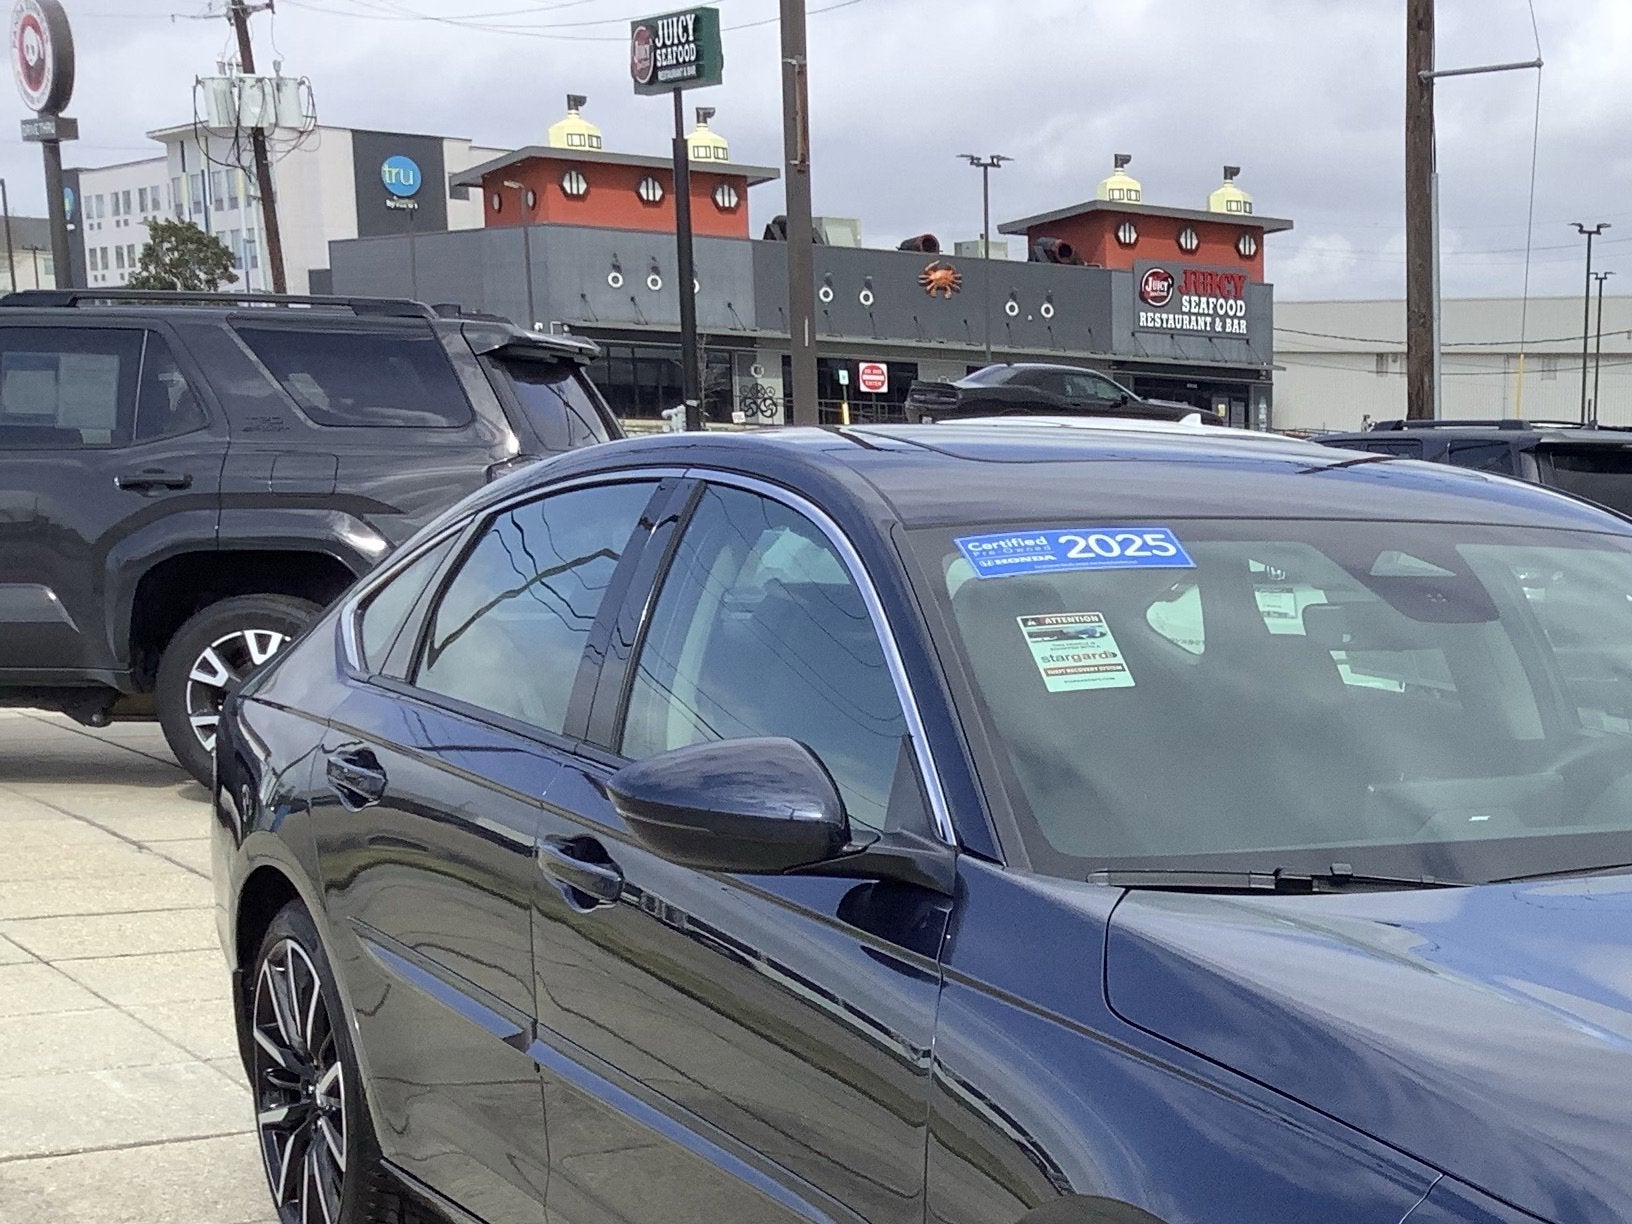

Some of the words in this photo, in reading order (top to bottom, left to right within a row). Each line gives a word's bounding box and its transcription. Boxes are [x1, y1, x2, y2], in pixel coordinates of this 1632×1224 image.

[655, 14, 696, 47] JUICY
[655, 43, 697, 67] SEAFOOD
[383, 163, 413, 186] tru
[1177, 269, 1247, 299] JUICY
[1181, 295, 1246, 317] SEAFOOD
[1139, 311, 1212, 331] RESTAURANT
[1214, 317, 1223, 333] &
[1225, 318, 1247, 334] BAR
[967, 536, 1048, 551] Certified
[1058, 533, 1177, 558] 2025
[995, 554, 1057, 566] HONDA
[1045, 615, 1099, 625] ATTENTION
